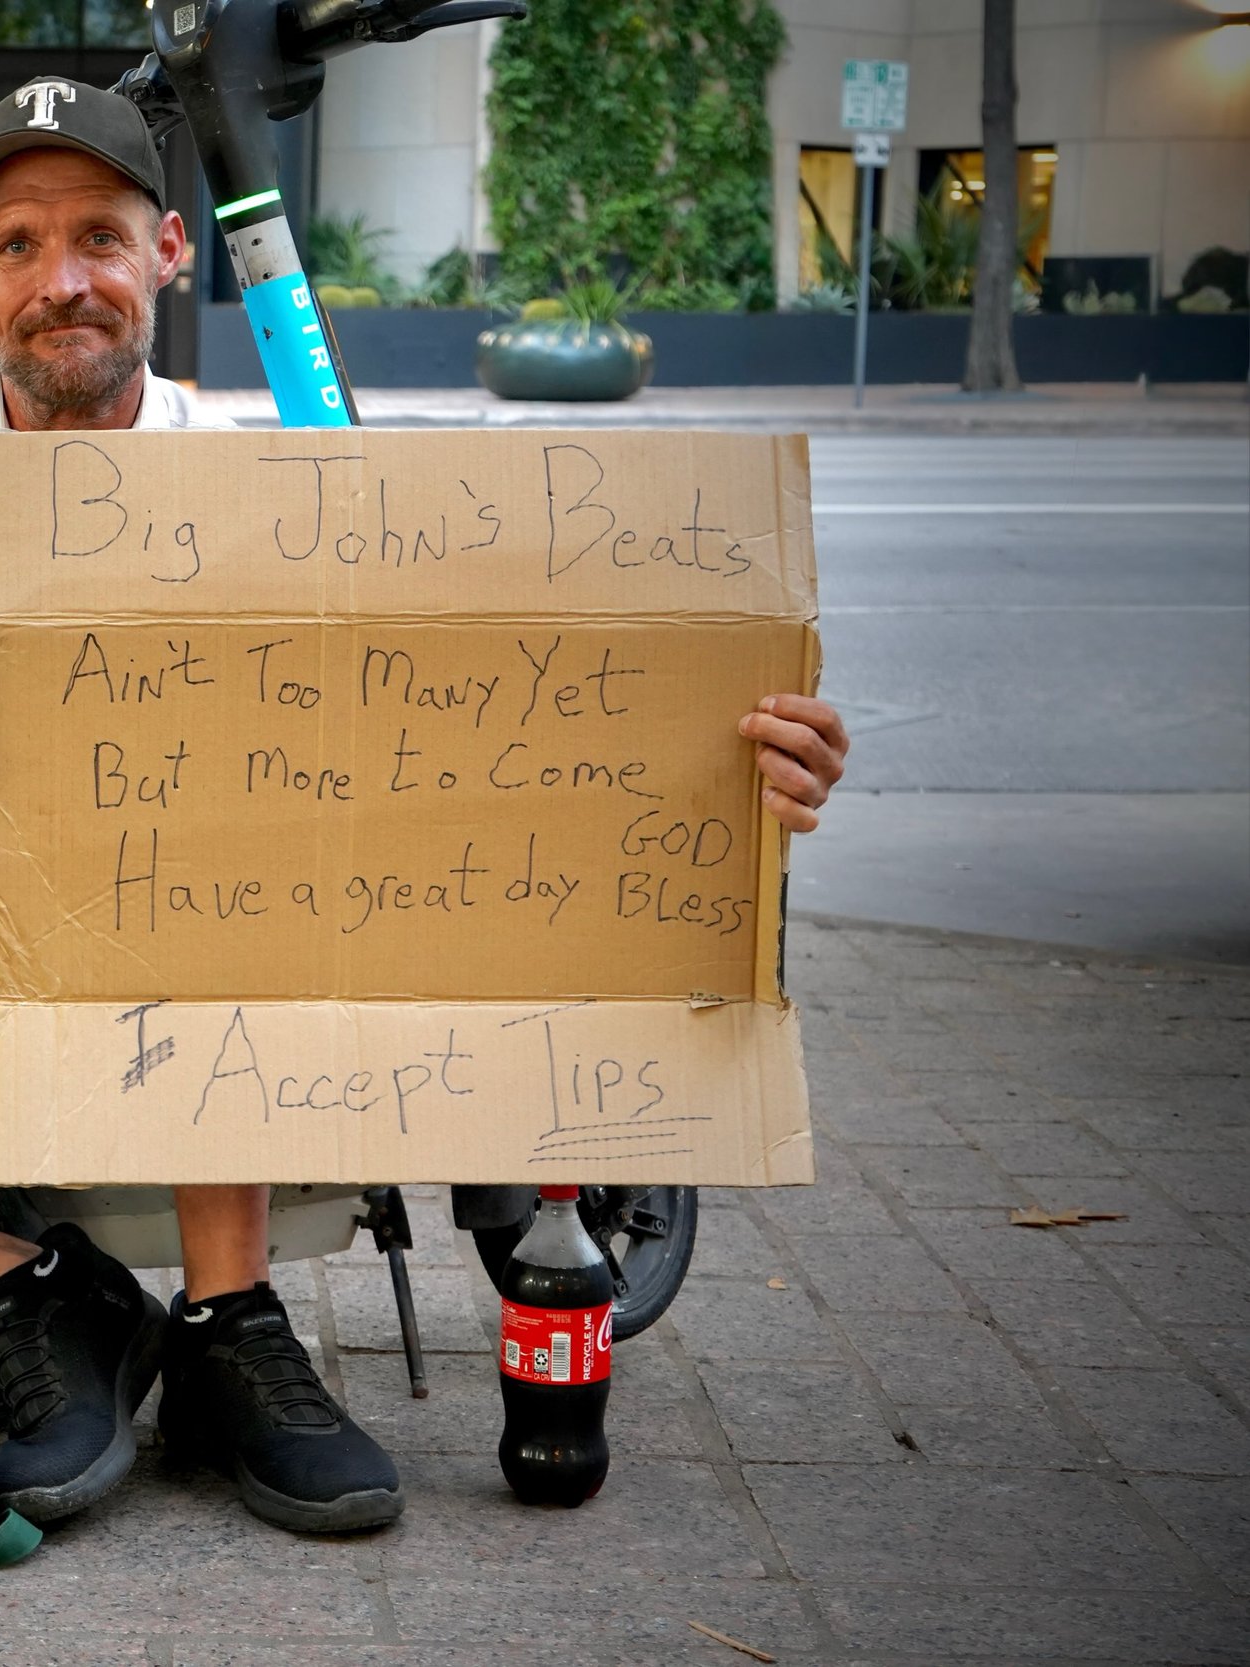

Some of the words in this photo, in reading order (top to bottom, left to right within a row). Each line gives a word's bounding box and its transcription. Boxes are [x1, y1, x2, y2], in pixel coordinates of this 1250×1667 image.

[15, 82, 76, 129] T
[291, 284, 340, 409] BIRD
[52, 440, 200, 582] Big
[543, 444, 752, 583] Beats
[247, 638, 321, 709] Too
[518, 635, 645, 726] Yet
[93, 740, 191, 809] But
[391, 728, 456, 791] to
[489, 744, 665, 800] Come
[621, 810, 733, 867] GOD
[115, 828, 268, 932] Have
[291, 883, 320, 916] a
[341, 842, 491, 934] great
[505, 833, 580, 926] day
[193, 1007, 473, 1134] Accept
[502, 999, 665, 1132] Tips
[242, 1315, 282, 1328] SKECHERS
[583, 1332, 592, 1381] RECYCLE
[584, 1312, 592, 1329] ME
